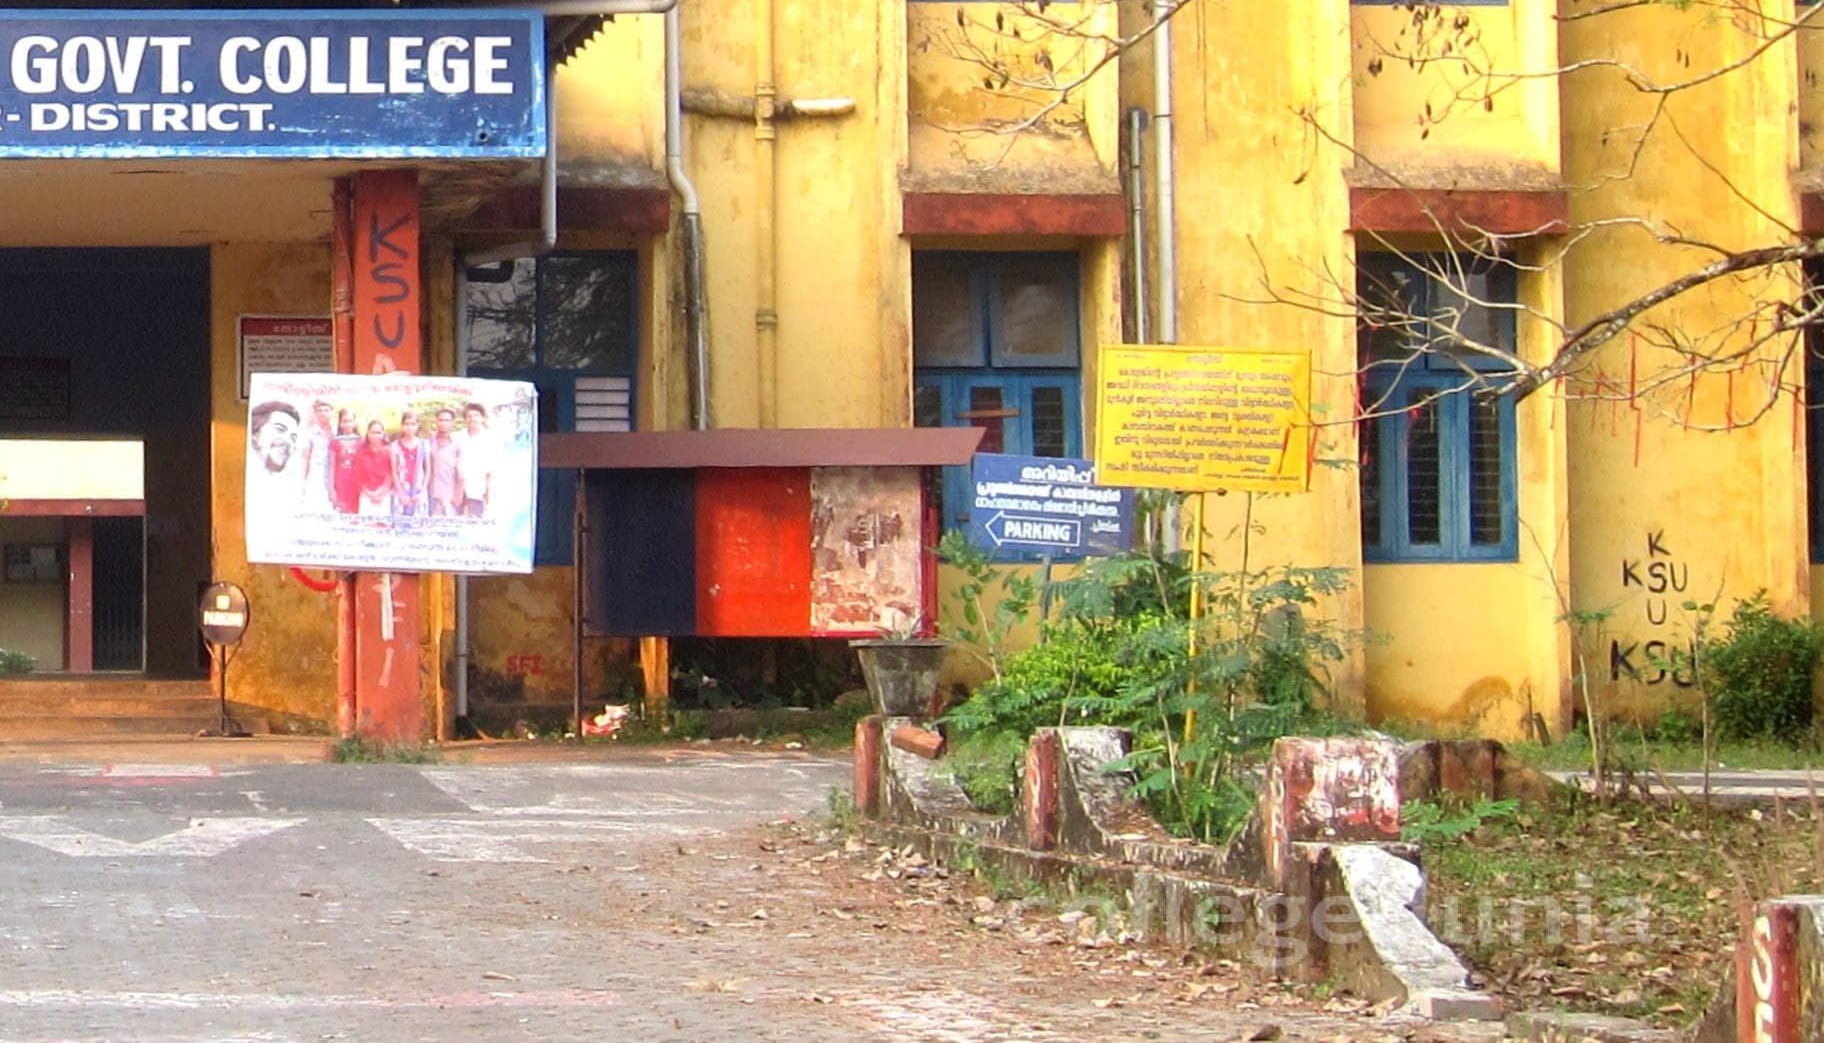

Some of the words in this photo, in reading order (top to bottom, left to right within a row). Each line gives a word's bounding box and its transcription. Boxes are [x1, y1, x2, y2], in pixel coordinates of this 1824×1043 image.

[10, 35, 195, 95] GOVT.
[219, 35, 514, 95] COLLEGE
[369, 212, 413, 349] KSU
[1003, 520, 1071, 542] PARKING
